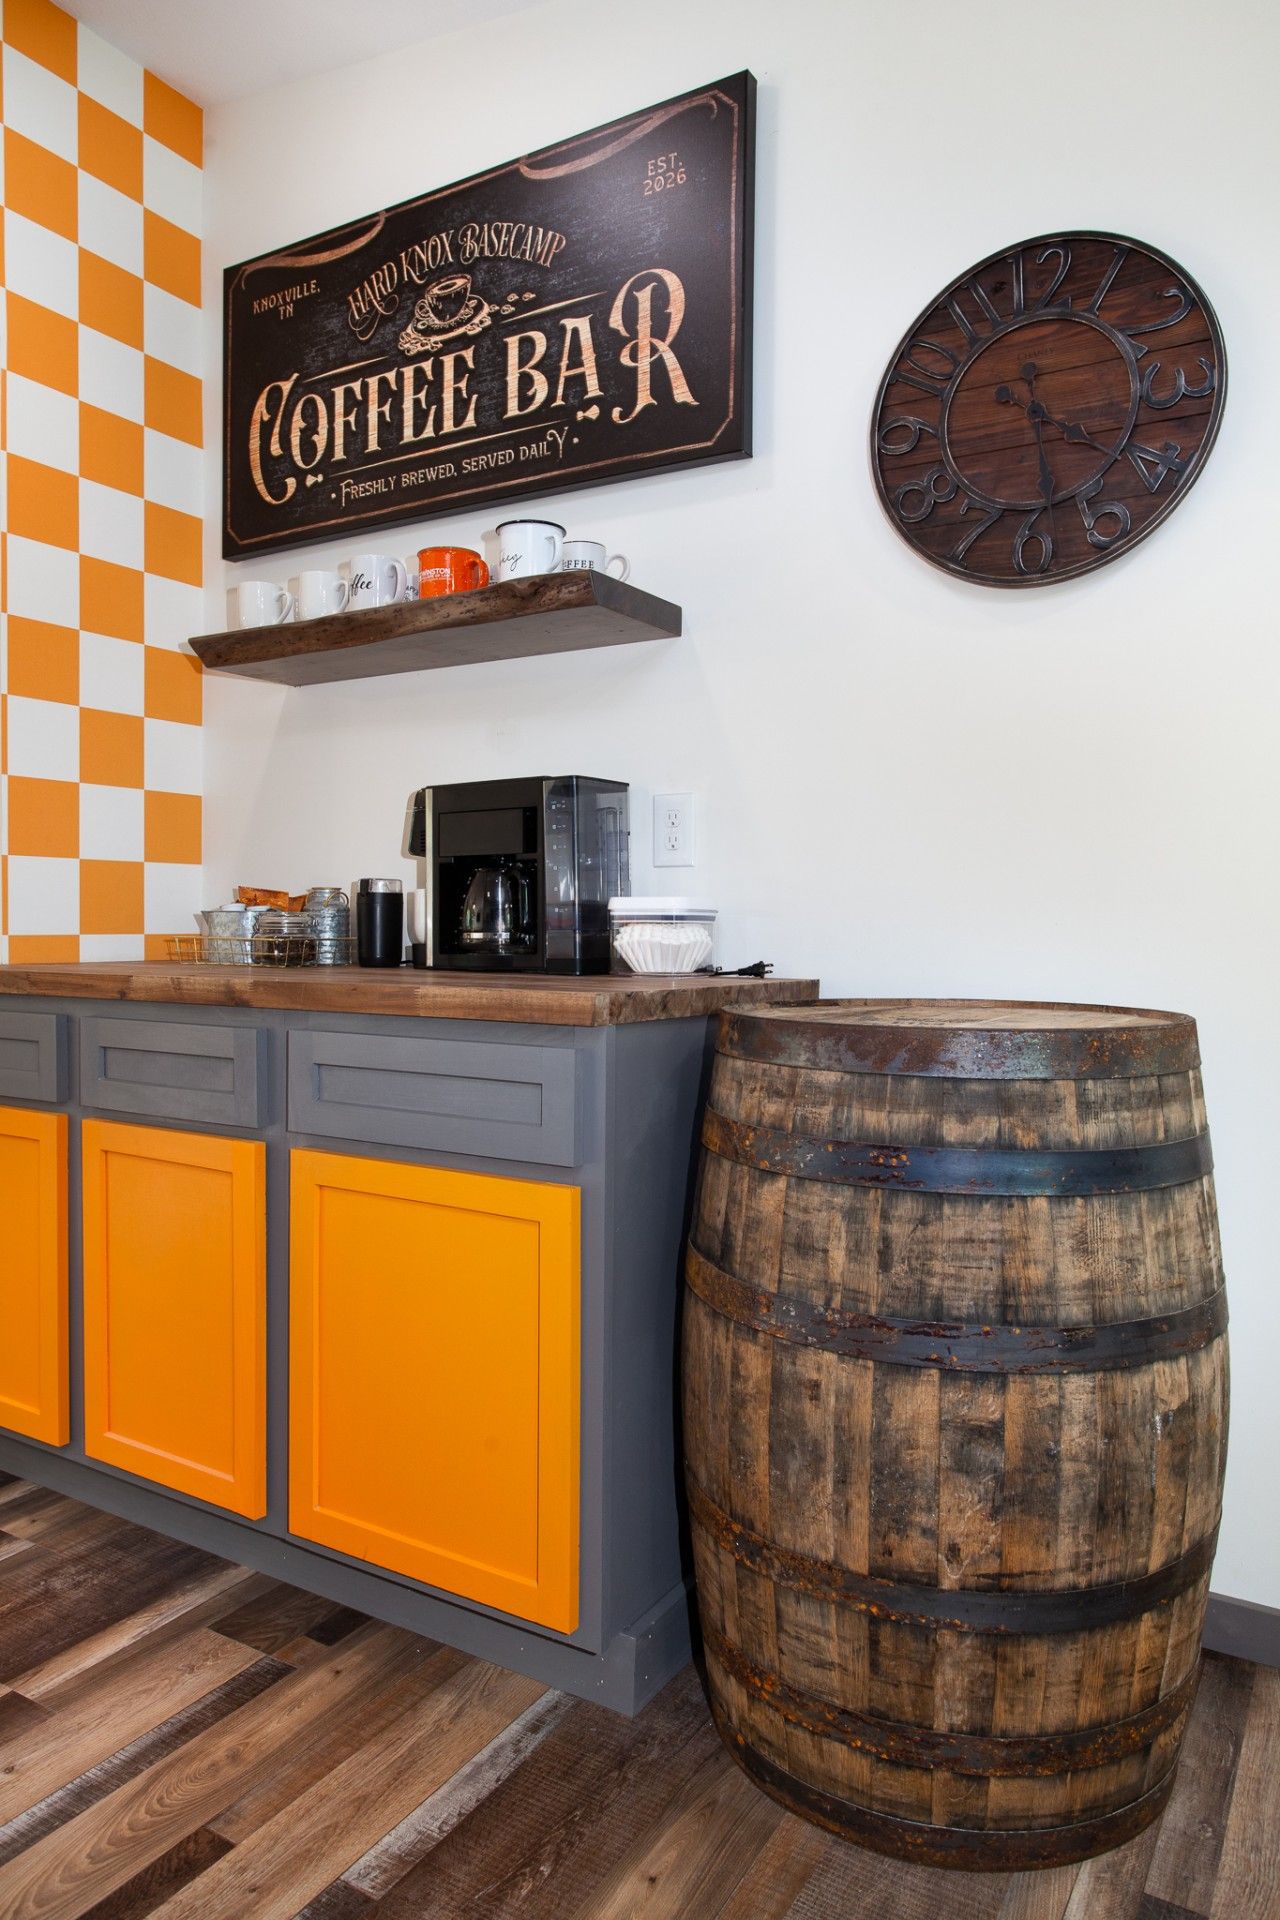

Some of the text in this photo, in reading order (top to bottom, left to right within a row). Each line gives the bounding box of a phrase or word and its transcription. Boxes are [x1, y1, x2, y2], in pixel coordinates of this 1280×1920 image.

[642, 168, 687, 196] 2026
[647, 152, 683, 176] EST.
[278, 303, 294, 320] TN
[347, 222, 566, 341] HARD KNOX BASECAMP
[940, 278, 1006, 347] 11
[1008, 248, 1072, 319] 12
[1084, 246, 1131, 317] 1
[1118, 288, 1196, 360] 2
[249, 268, 700, 506] COFFEE BAR
[888, 339, 962, 400] 10
[1140, 357, 1216, 409] 3
[340, 475, 397, 508] FRESHLY
[462, 449, 515, 474] SERVED
[519, 426, 570, 462] DAILY
[878, 416, 940, 455] 9
[1124, 441, 1197, 493] 4
[896, 466, 959, 523] 8
[1075, 477, 1131, 550] 5
[949, 499, 1006, 569] 7
[1013, 507, 1053, 576] 6
